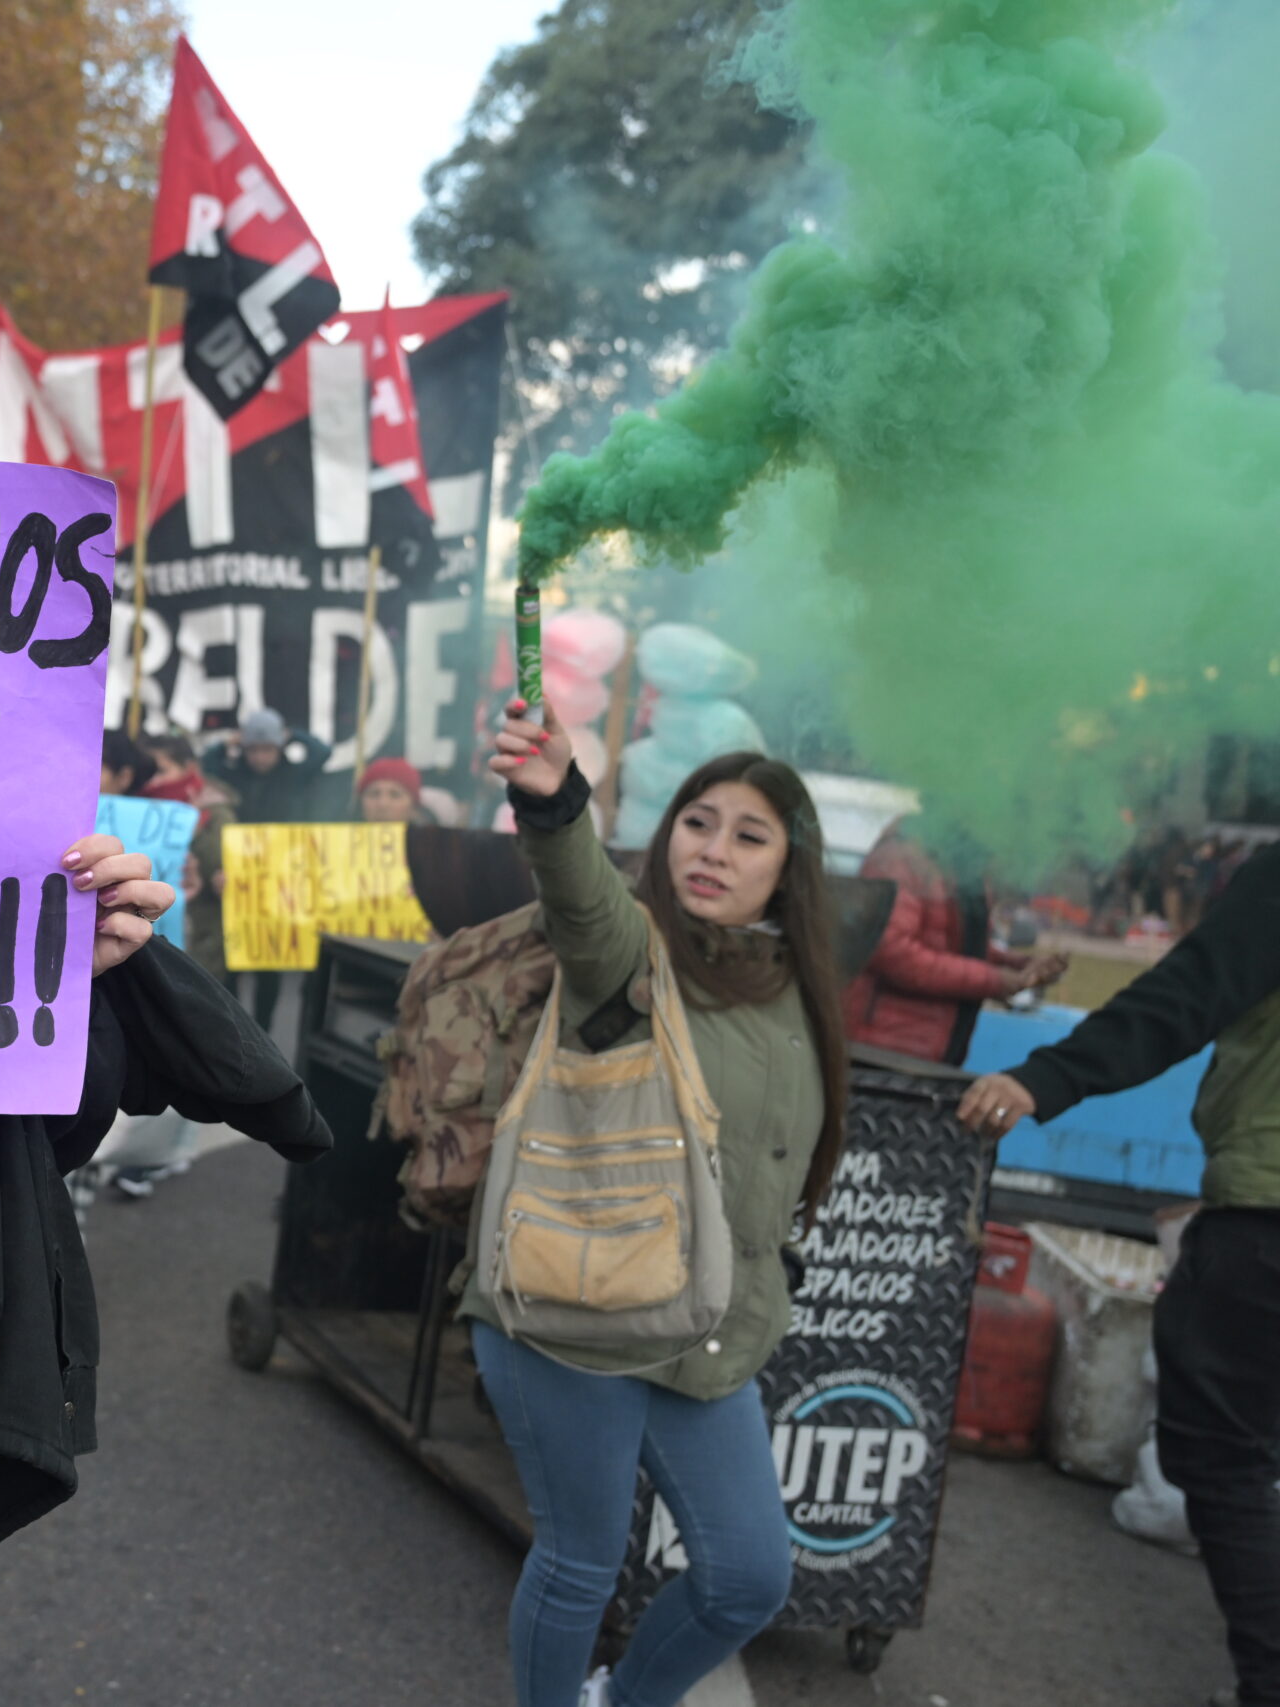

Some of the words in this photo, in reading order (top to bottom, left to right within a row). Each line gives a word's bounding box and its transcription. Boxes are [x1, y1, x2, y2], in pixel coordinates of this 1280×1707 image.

[836, 1151, 882, 1188] MA
[771, 1424, 928, 1506] UTEP
[793, 1501, 875, 1526] CAPITAL
